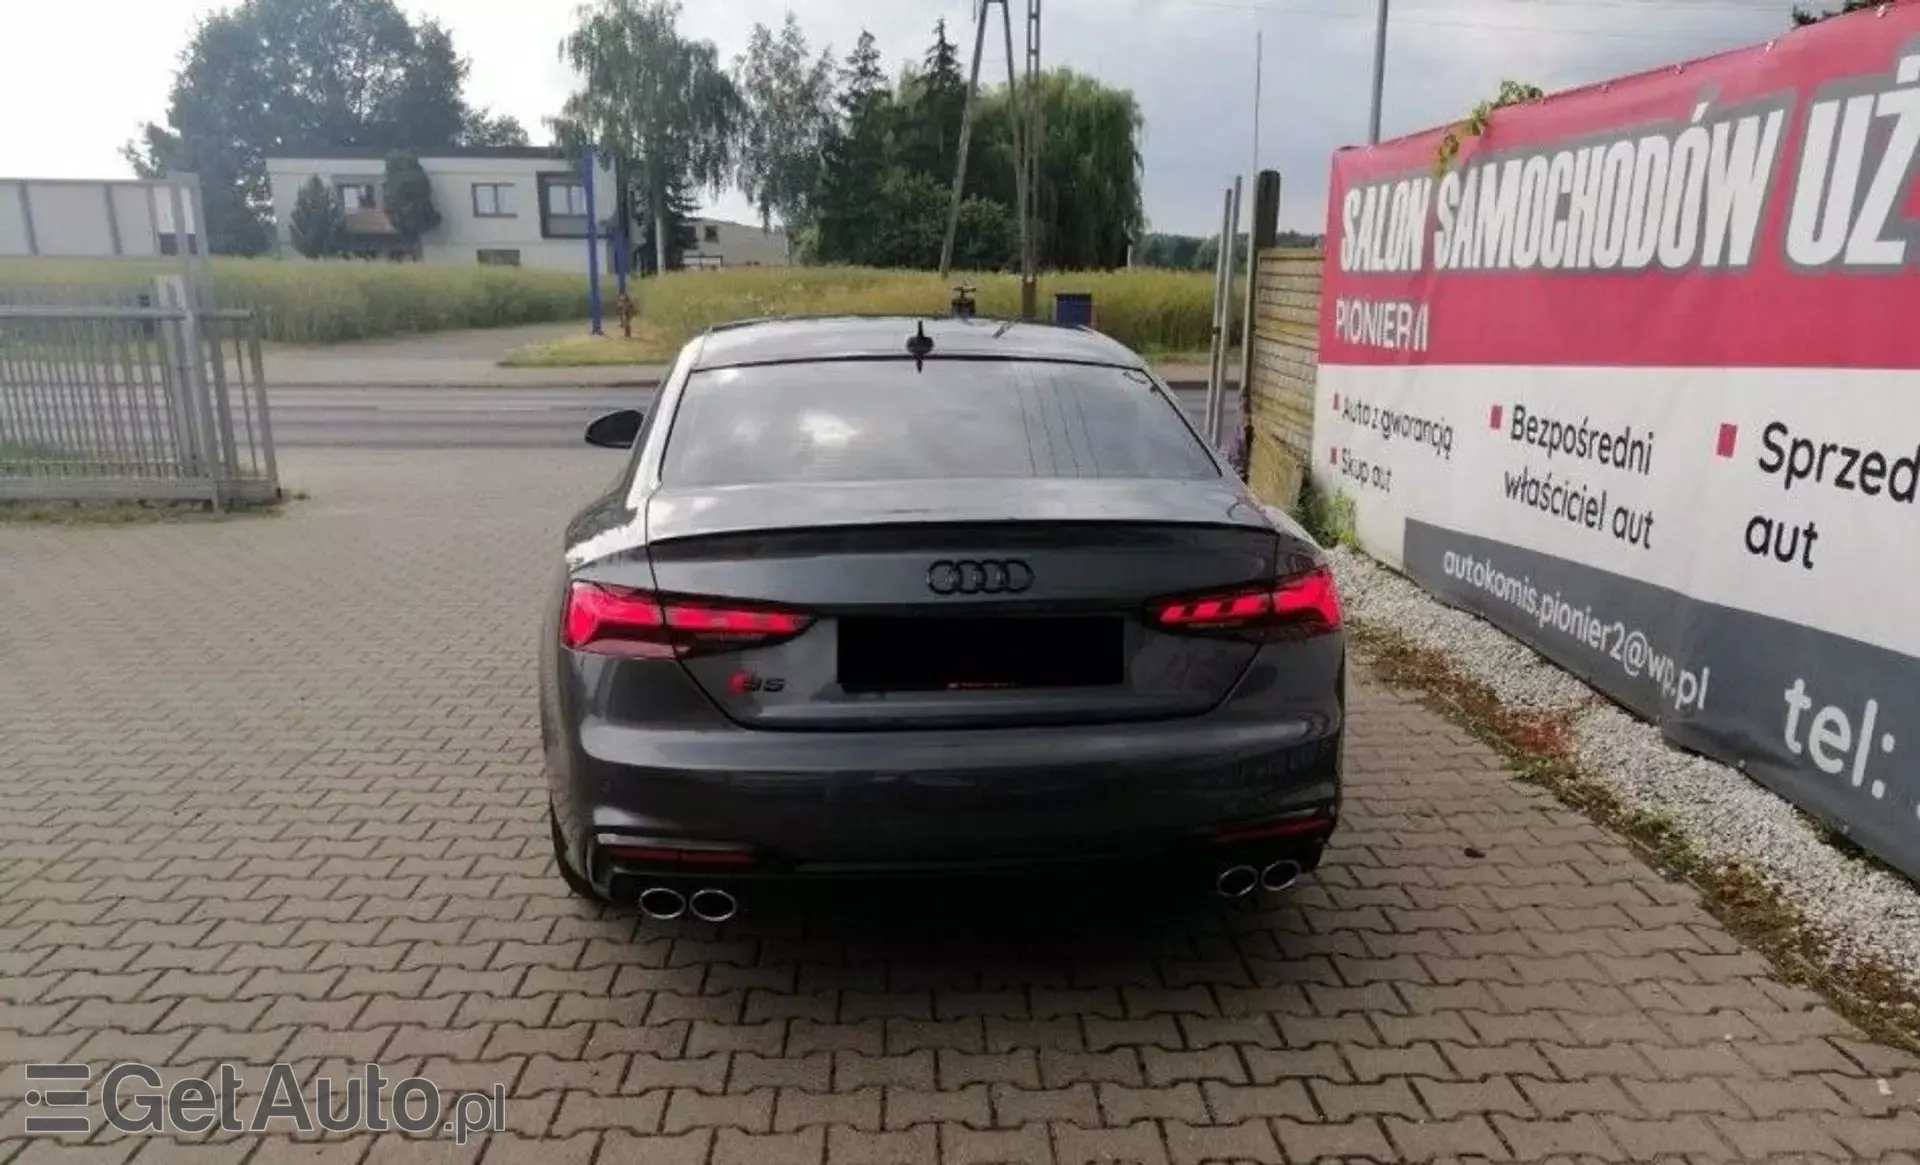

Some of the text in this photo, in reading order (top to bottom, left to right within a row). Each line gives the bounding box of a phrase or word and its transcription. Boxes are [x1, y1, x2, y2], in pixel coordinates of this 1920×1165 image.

[1341, 176, 1432, 273] SALON
[1434, 102, 1784, 270] SAMOCHODÓW
[1335, 298, 1412, 351] PIONIER
[1342, 397, 1370, 426] Auto
[1511, 404, 1654, 476] Bezpośredni
[1342, 448, 1392, 494] Skup aut
[1758, 421, 1920, 504] Sprzed
[1504, 465, 1654, 550] właściciel aut
[1745, 515, 1819, 570] aut
[1443, 550, 1710, 710] autokomis.pionier2@wp.pl
[1784, 678, 1896, 799] tel:
